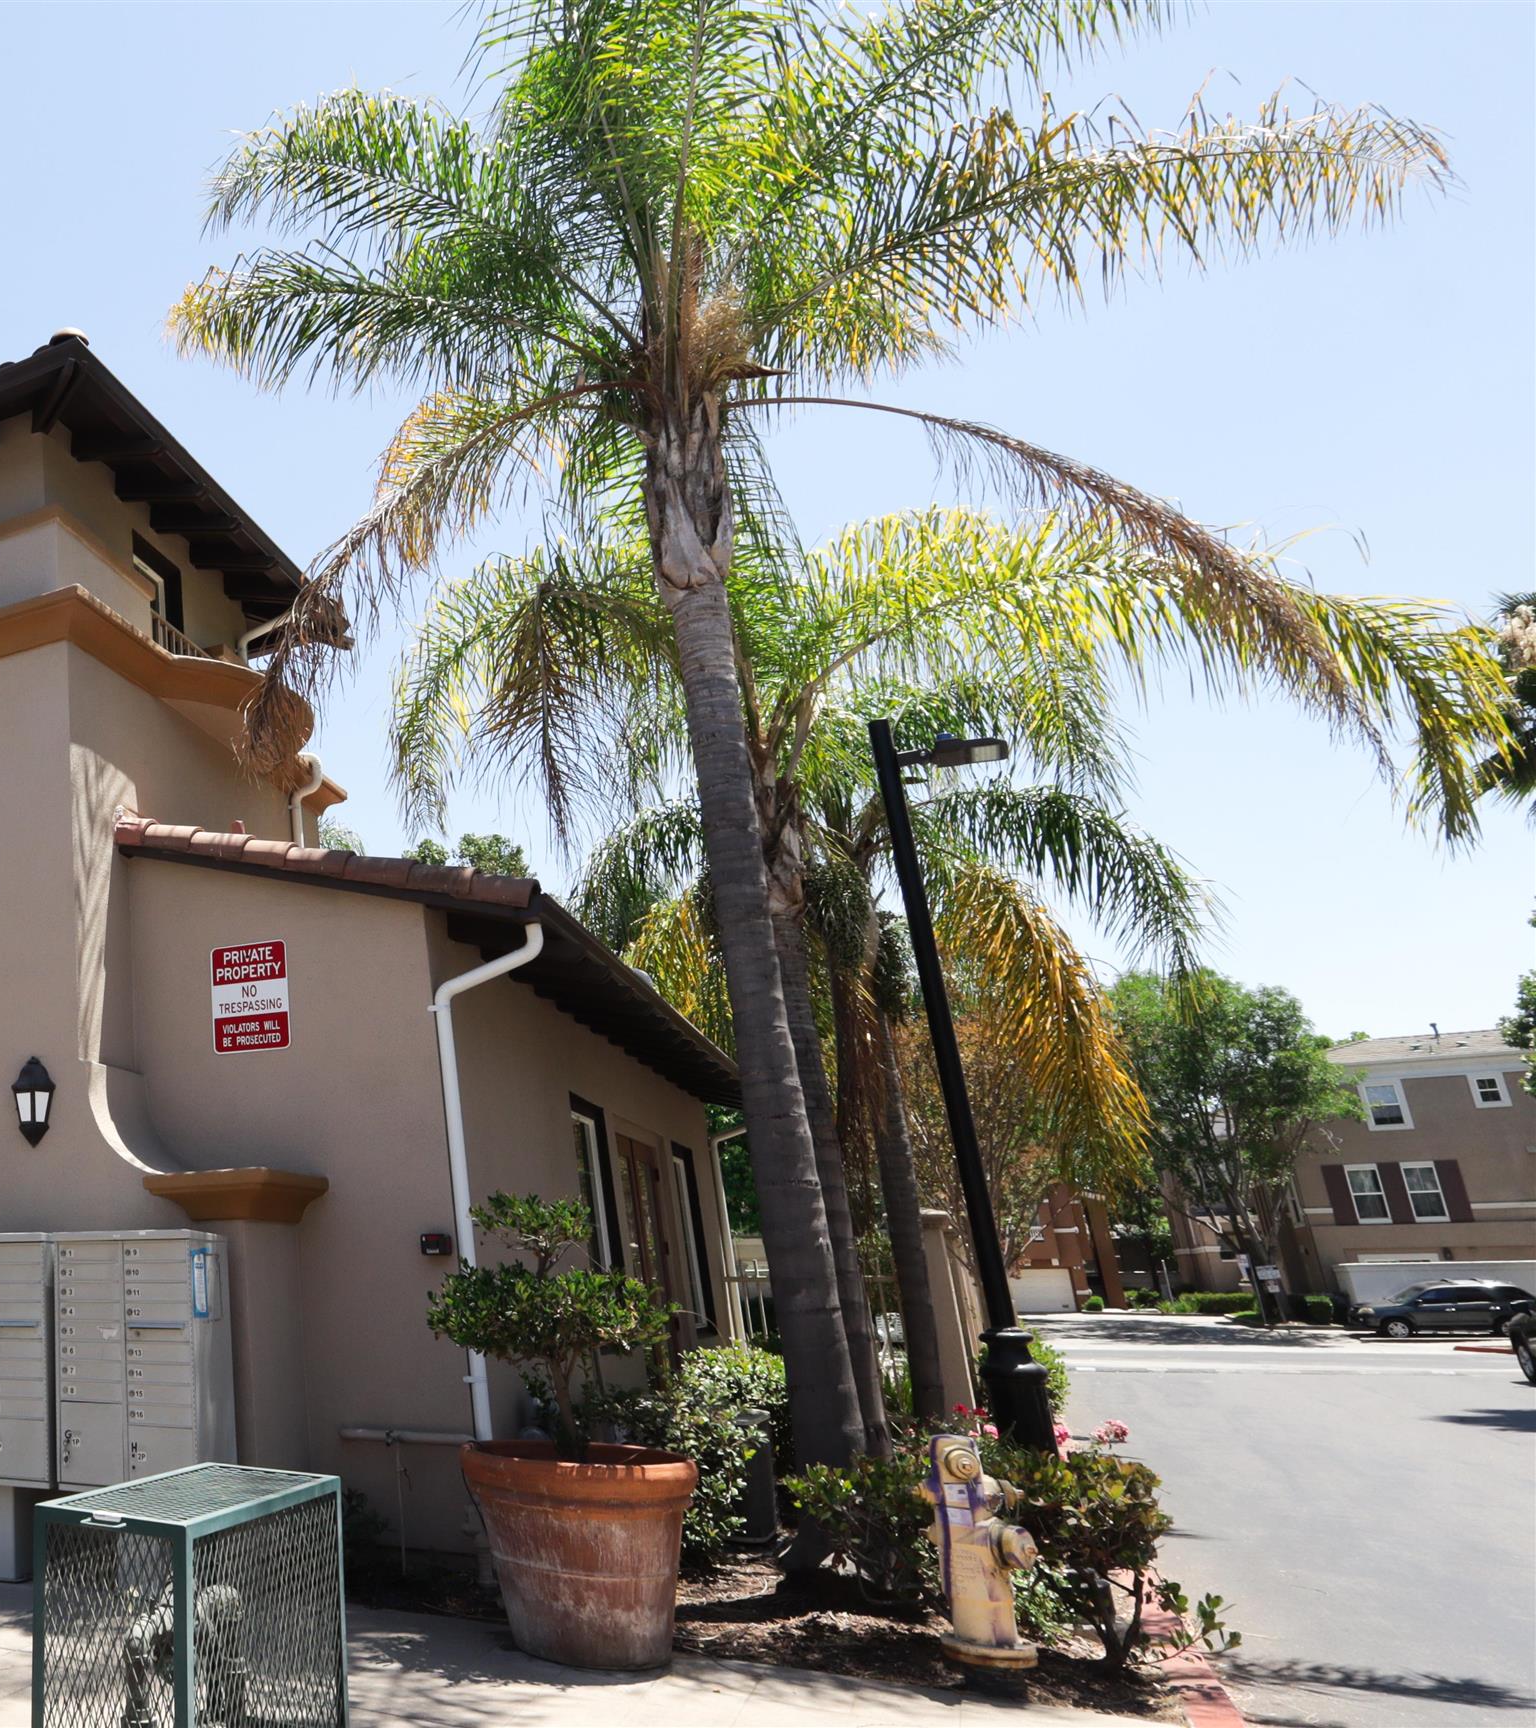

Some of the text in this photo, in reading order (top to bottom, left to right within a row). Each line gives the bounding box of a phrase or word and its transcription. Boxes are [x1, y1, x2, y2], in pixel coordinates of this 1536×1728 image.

[223, 946, 274, 965] PRIVATE
[216, 961, 282, 981] PROPERTY
[241, 985, 257, 998] NO
[219, 998, 283, 1014] TRESPASSING
[222, 1019, 281, 1035] VIOLATORS WILL
[223, 1033, 282, 1048] BE PROSECUTED
[132, 1289, 140, 1297] 11
[134, 1349, 142, 1357] 13
[135, 1390, 143, 1398] 15
[64, 1429, 72, 1439] G
[131, 1442, 138, 1452] H
